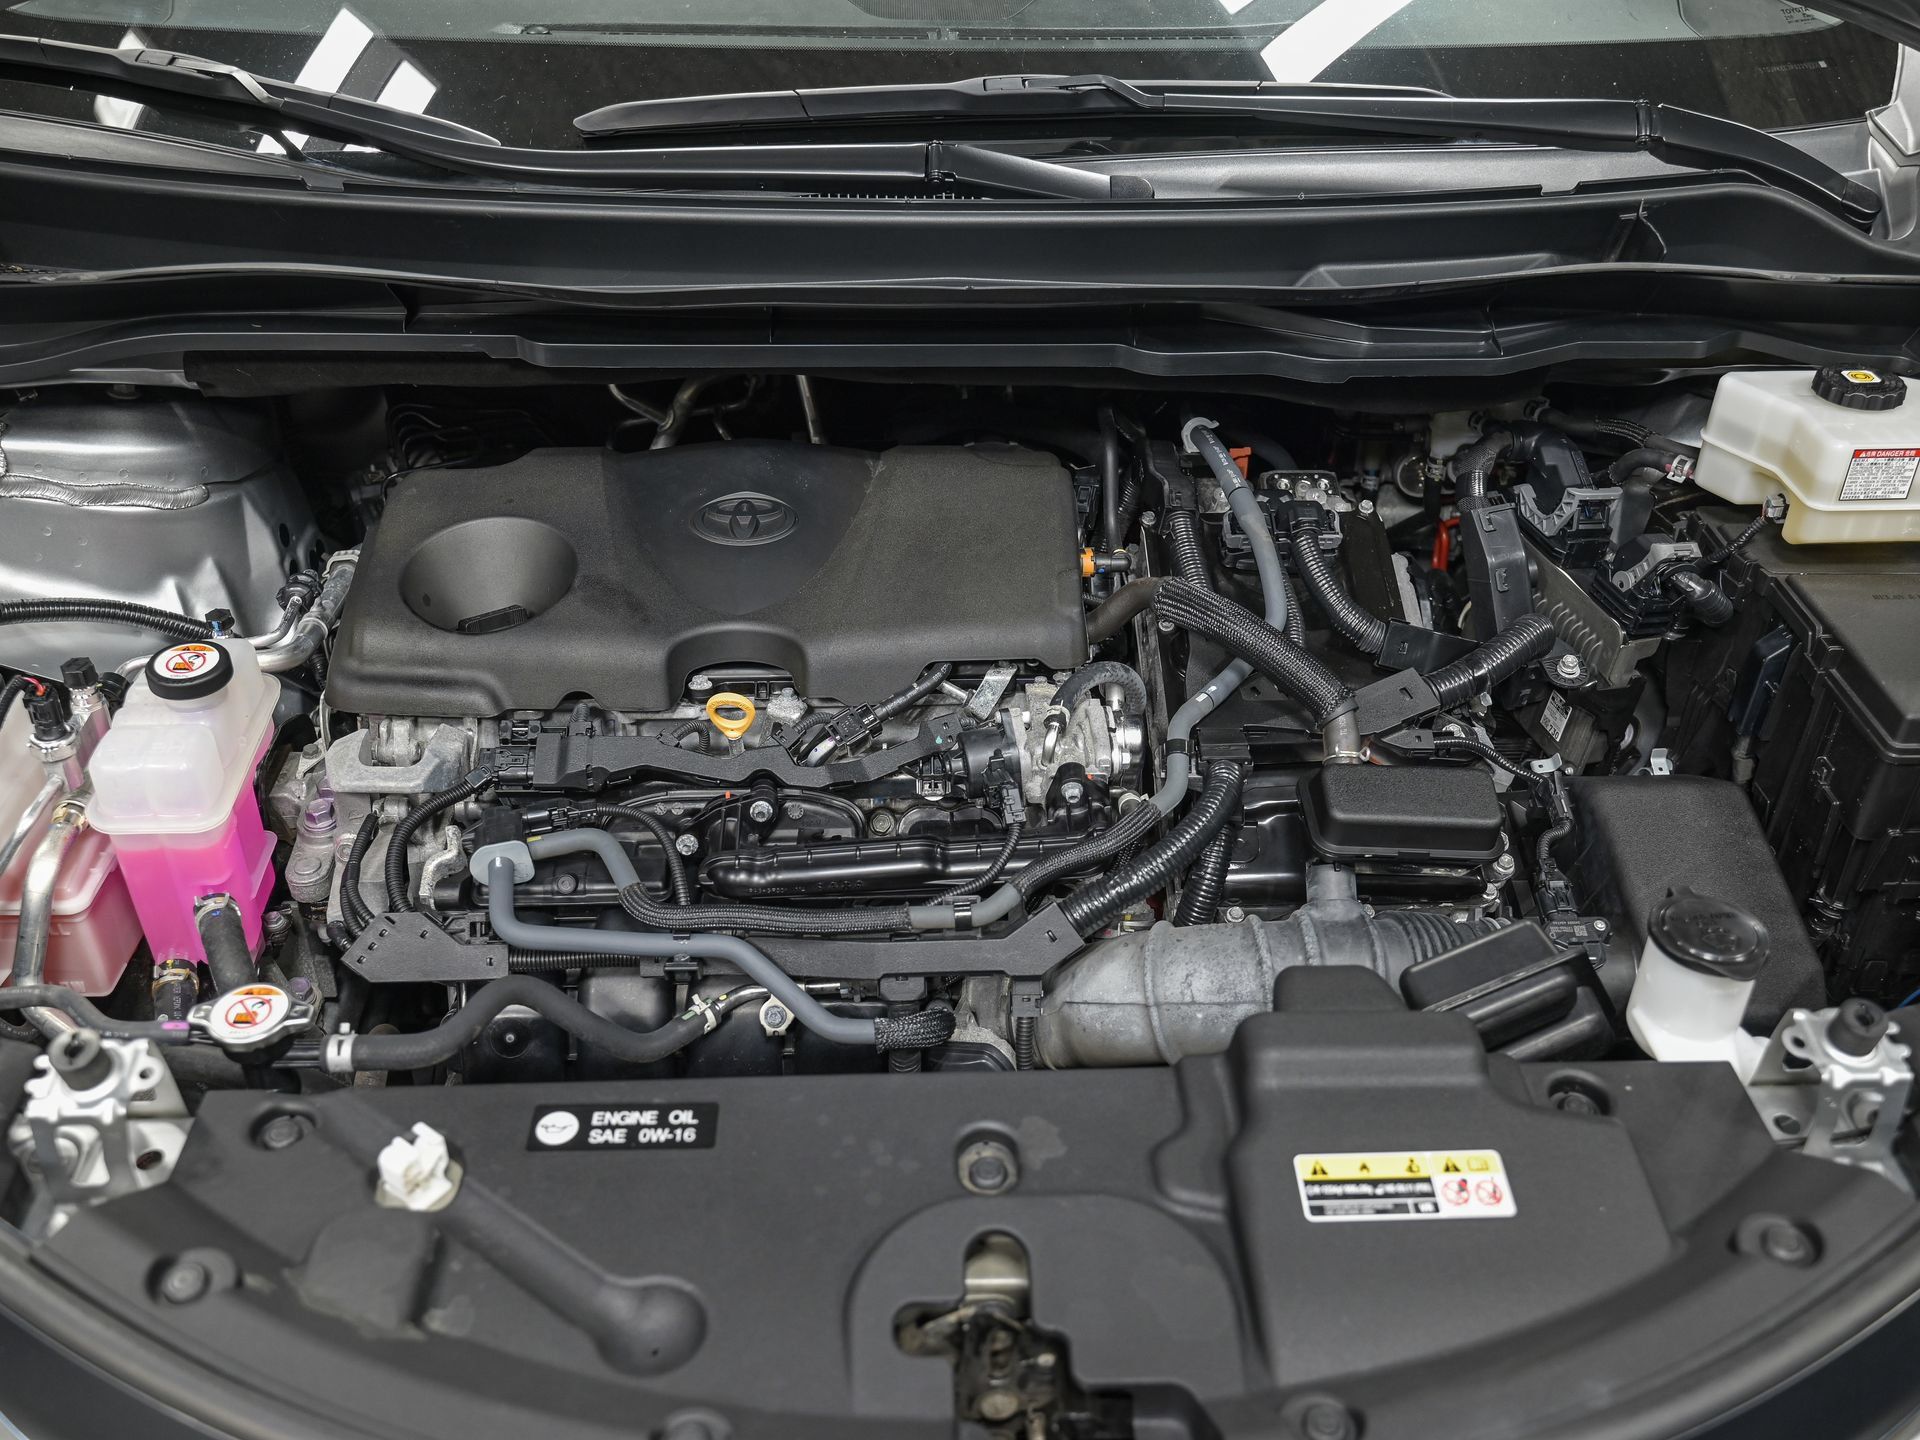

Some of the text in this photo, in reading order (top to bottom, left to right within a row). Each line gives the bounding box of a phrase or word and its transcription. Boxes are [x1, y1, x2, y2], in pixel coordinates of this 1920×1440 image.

[1781, 6, 1810, 15] TOYOTA
[1548, 724, 1560, 739] 730
[591, 1109, 699, 1126] ENGINE OIL
[588, 1127, 697, 1144] SAE 0W-16
